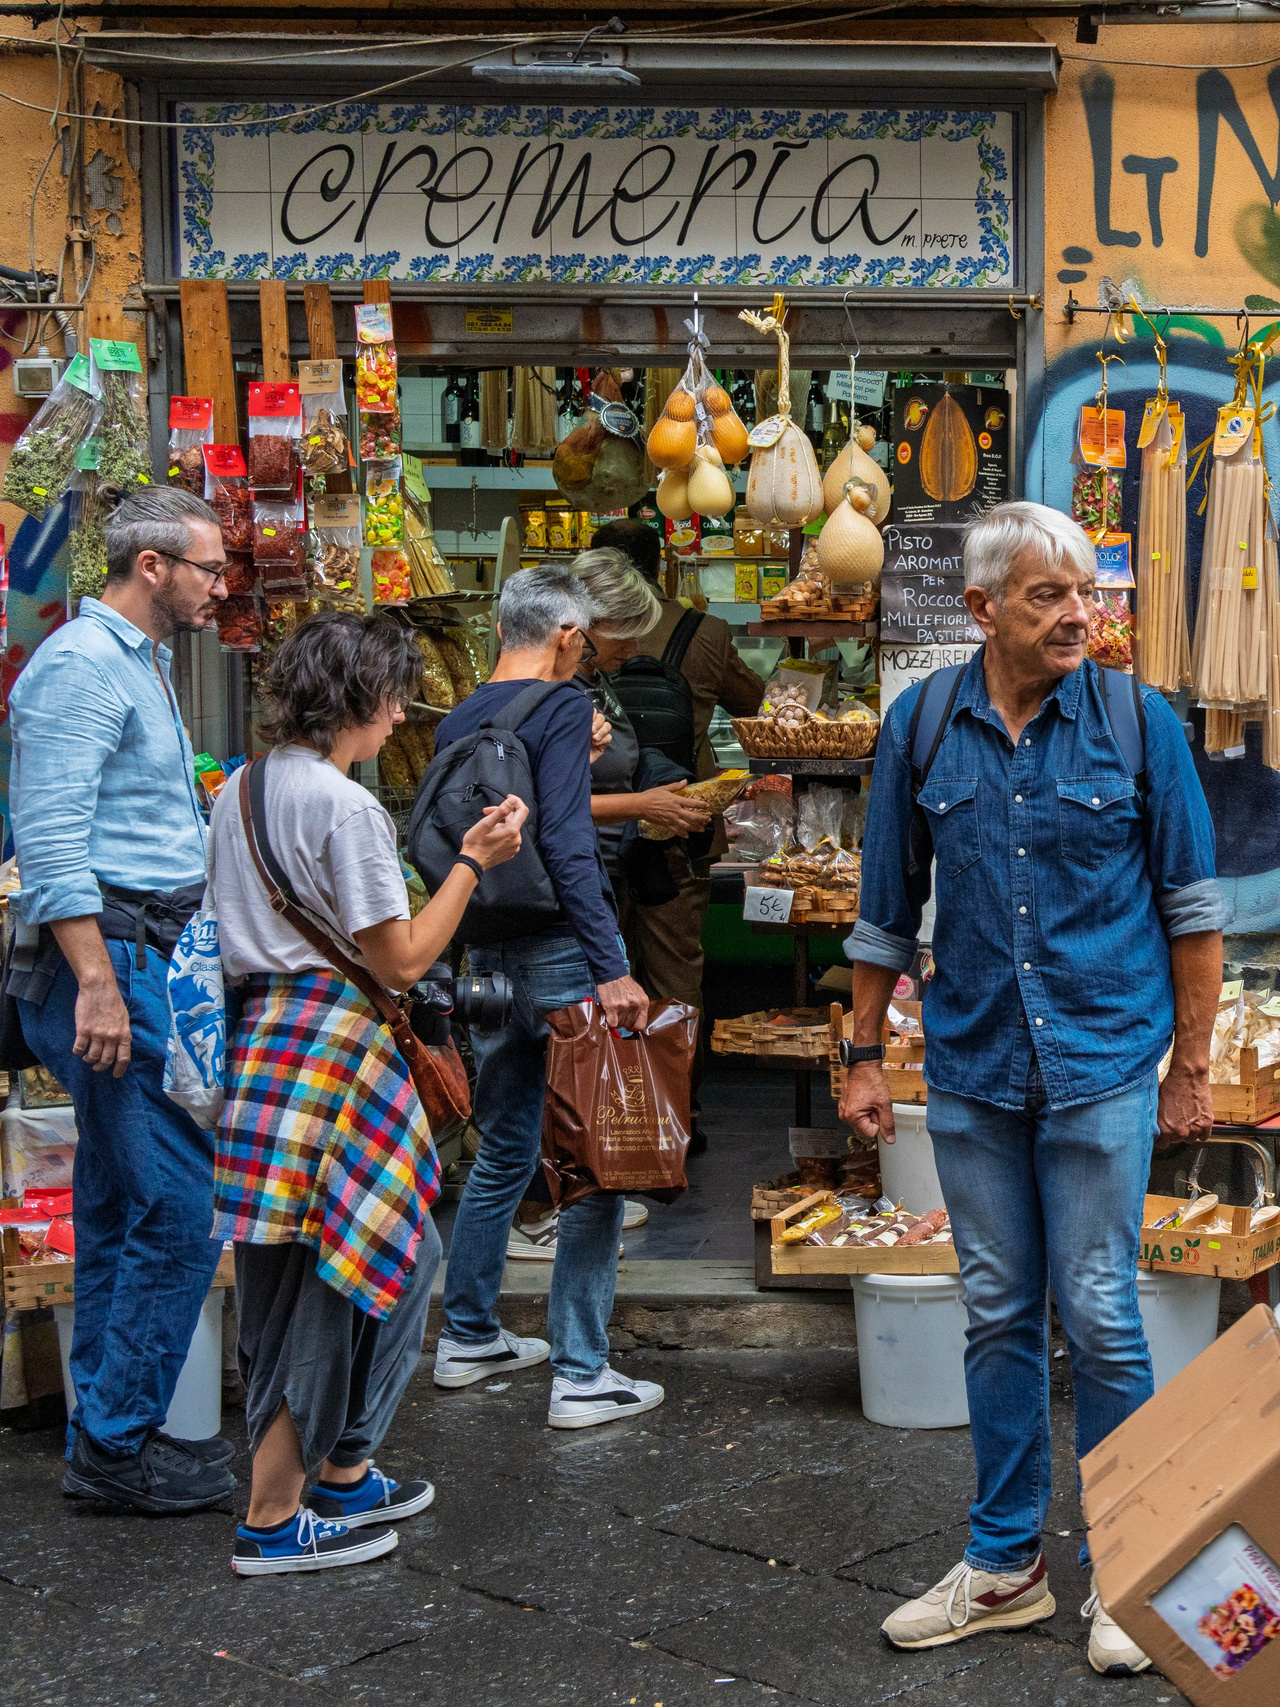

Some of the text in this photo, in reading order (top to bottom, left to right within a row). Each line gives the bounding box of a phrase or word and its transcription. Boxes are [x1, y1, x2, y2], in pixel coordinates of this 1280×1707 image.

[888, 529, 933, 551] PISTO
[922, 575, 945, 587] PER
[887, 611, 967, 627] MILLEFIORI
[917, 626, 981, 643] PASTIERA
[1252, 1241, 1275, 1262] ITALIA
